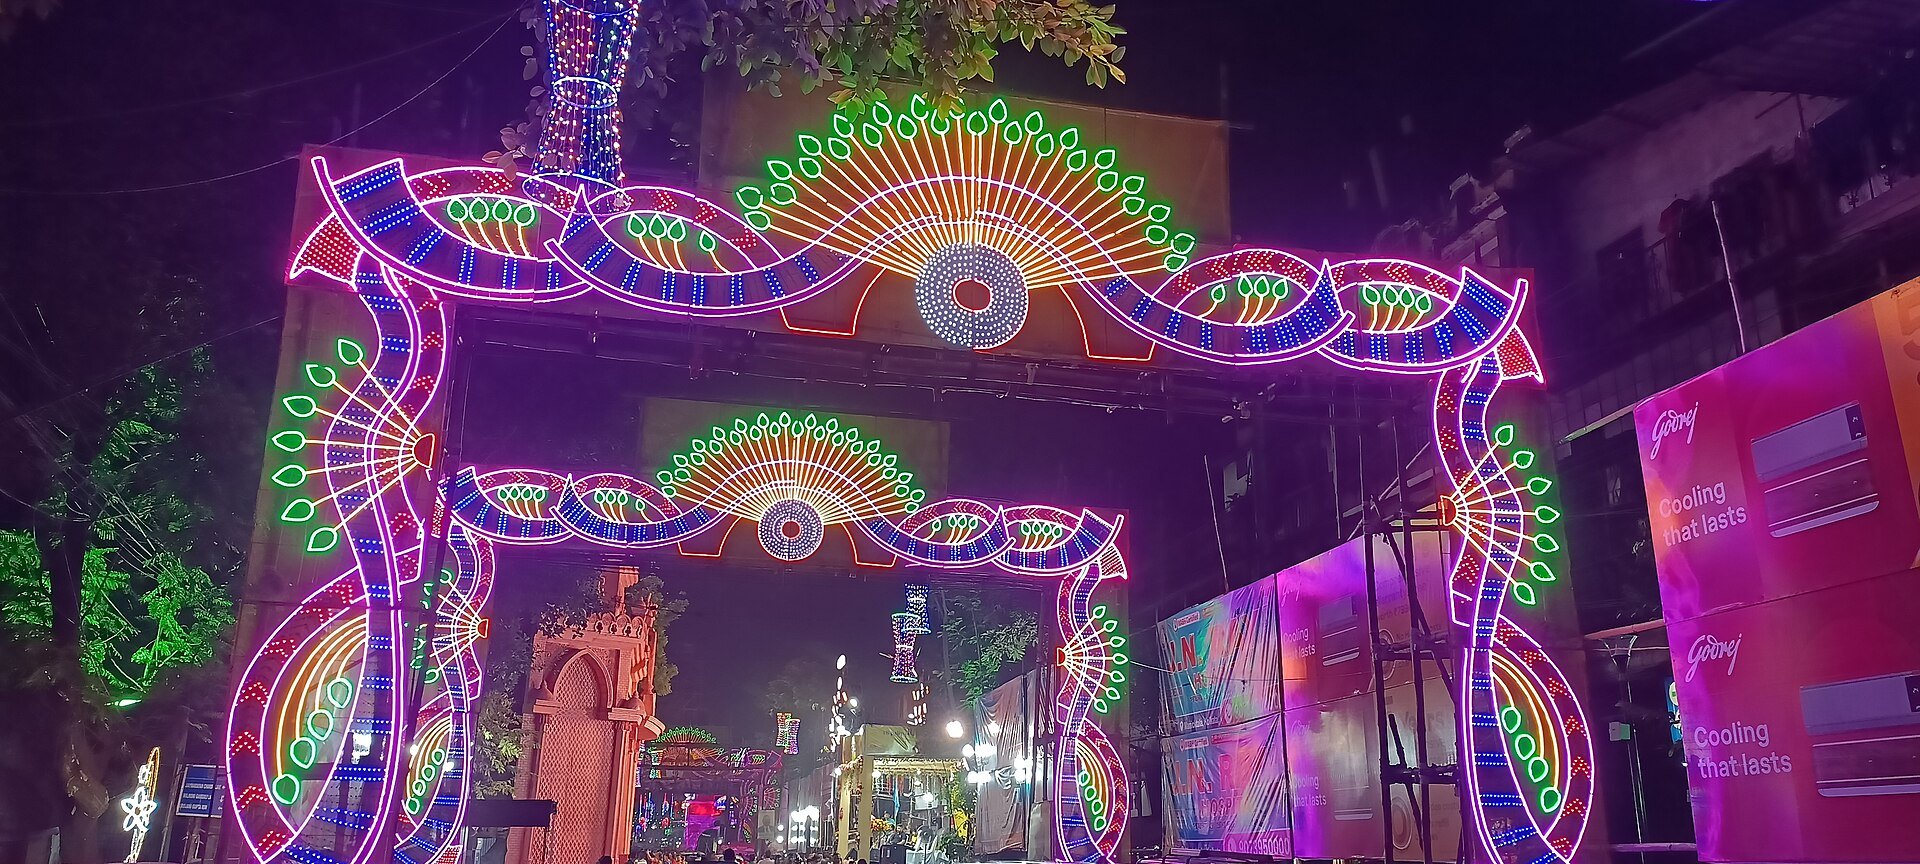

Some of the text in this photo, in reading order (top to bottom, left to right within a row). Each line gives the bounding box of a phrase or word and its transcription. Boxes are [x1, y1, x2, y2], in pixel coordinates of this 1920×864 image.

[1650, 401, 1699, 460] Godrej
[1659, 481, 1726, 518] Cooling
[1663, 506, 1747, 547] that lasts
[1685, 633, 1742, 682] Godrej
[1694, 721, 1769, 748] Cooling
[1698, 751, 1792, 779] that lasts
